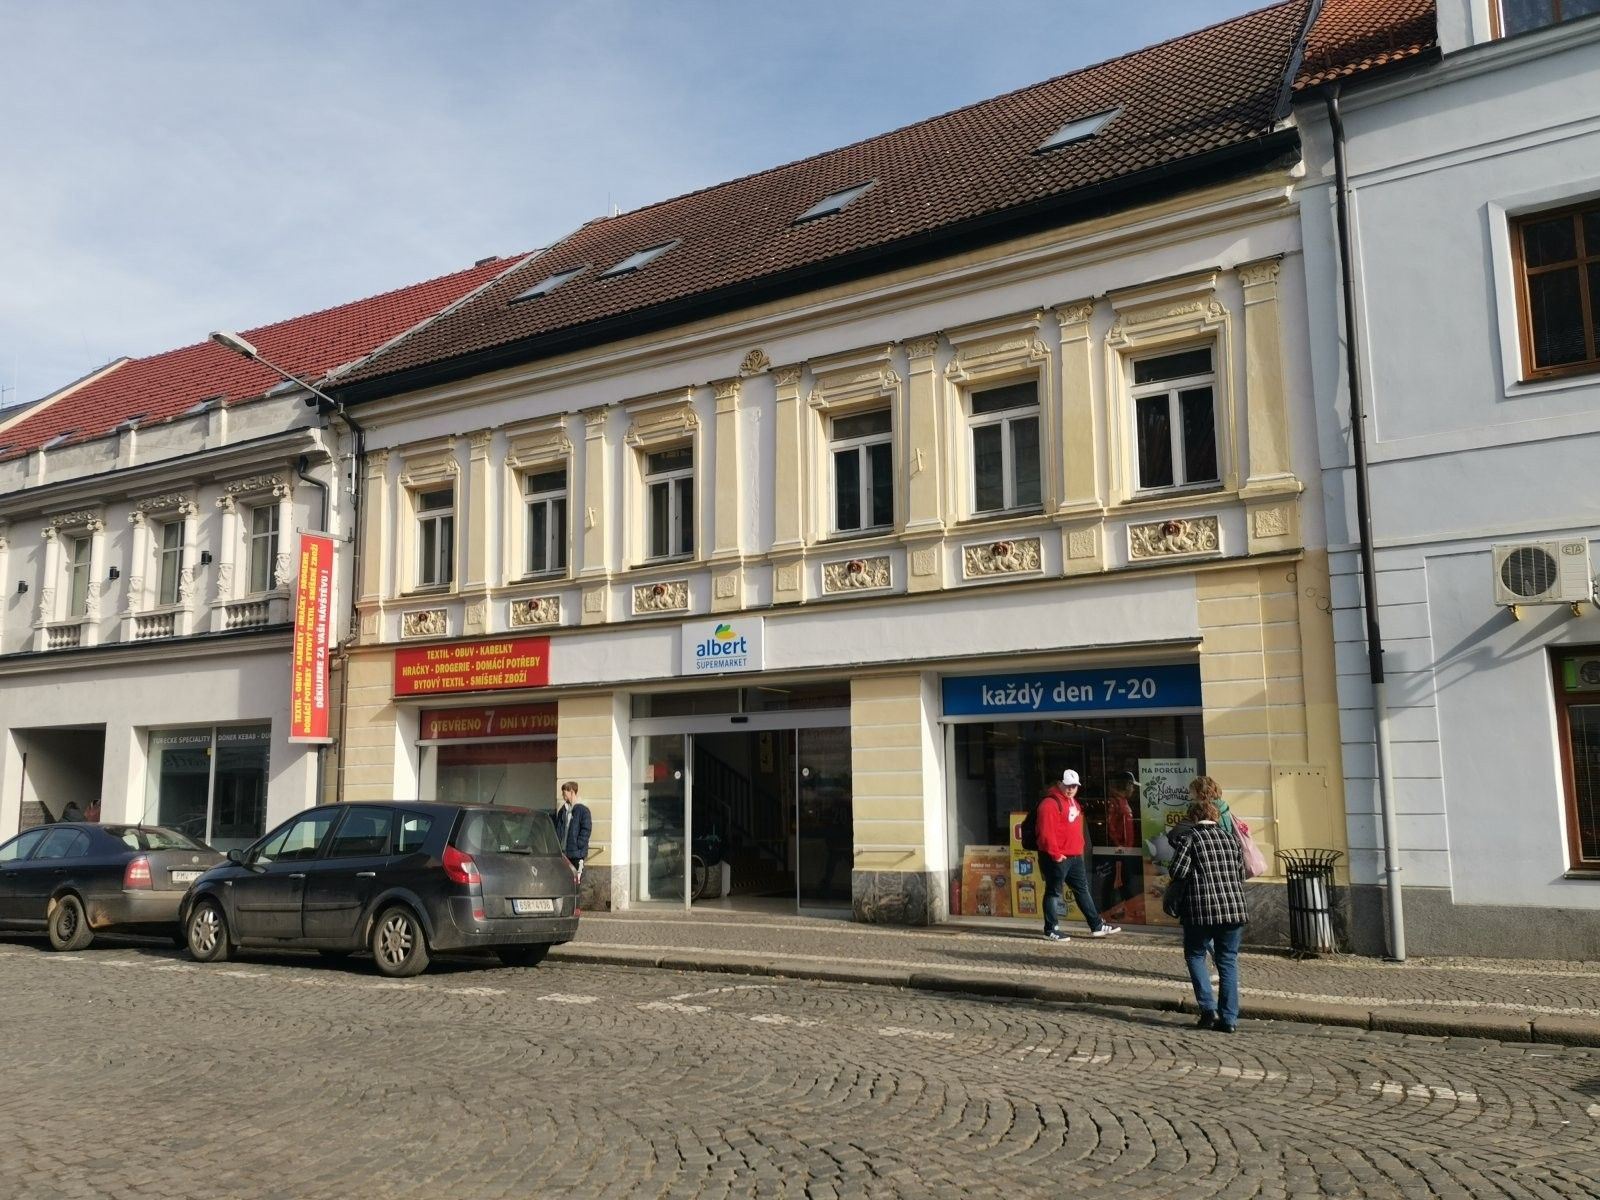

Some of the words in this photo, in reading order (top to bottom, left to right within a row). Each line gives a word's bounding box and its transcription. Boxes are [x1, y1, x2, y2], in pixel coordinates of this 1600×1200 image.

[310, 544, 318, 566] ZBOŽÍ
[1565, 545, 1581, 554] ETA
[300, 552, 309, 590] DROGERIE
[308, 568, 317, 600] SMÍŠENÉ
[318, 576, 328, 622] NÁVŠTĚVU
[298, 596, 306, 626] HRAČKY
[306, 607, 315, 630] TEXTIL
[317, 624, 326, 644] VAŠI
[296, 632, 304, 666] KABELKY
[305, 632, 314, 662] BYTOVÝ
[316, 646, 324, 659] ZA
[427, 650, 449, 660] TEXTIL
[455, 647, 474, 658] OBUV
[480, 644, 514, 656] KABELKY
[696, 636, 747, 657] albert
[402, 663, 430, 676] HRAČKY
[435, 661, 470, 674] DROGERIE
[476, 658, 504, 670] DOMÁCÍ
[506, 655, 541, 668] POTŘEBY
[696, 658, 747, 670] SUPERMARKET
[304, 668, 312, 701] POTŘEBY
[314, 660, 324, 708] DĚKUJEME
[414, 678, 440, 690] BYTOVÝ
[442, 679, 465, 689] TEXTIL
[470, 672, 502, 686] SMÍŠENÉ
[504, 670, 527, 683] ZBOŽÍ
[982, 681, 1044, 710] každý
[1053, 681, 1094, 703] den
[1103, 678, 1157, 700] 7-20
[294, 698, 302, 724] TEXTIL
[303, 702, 312, 734] DOMÁCÍ
[430, 716, 481, 732] OTEVŘENO
[484, 710, 495, 734] 7
[521, 717, 528, 728] V
[178, 735, 210, 744] SPECIALITY
[1154, 766, 1194, 774] PORCELÁN
